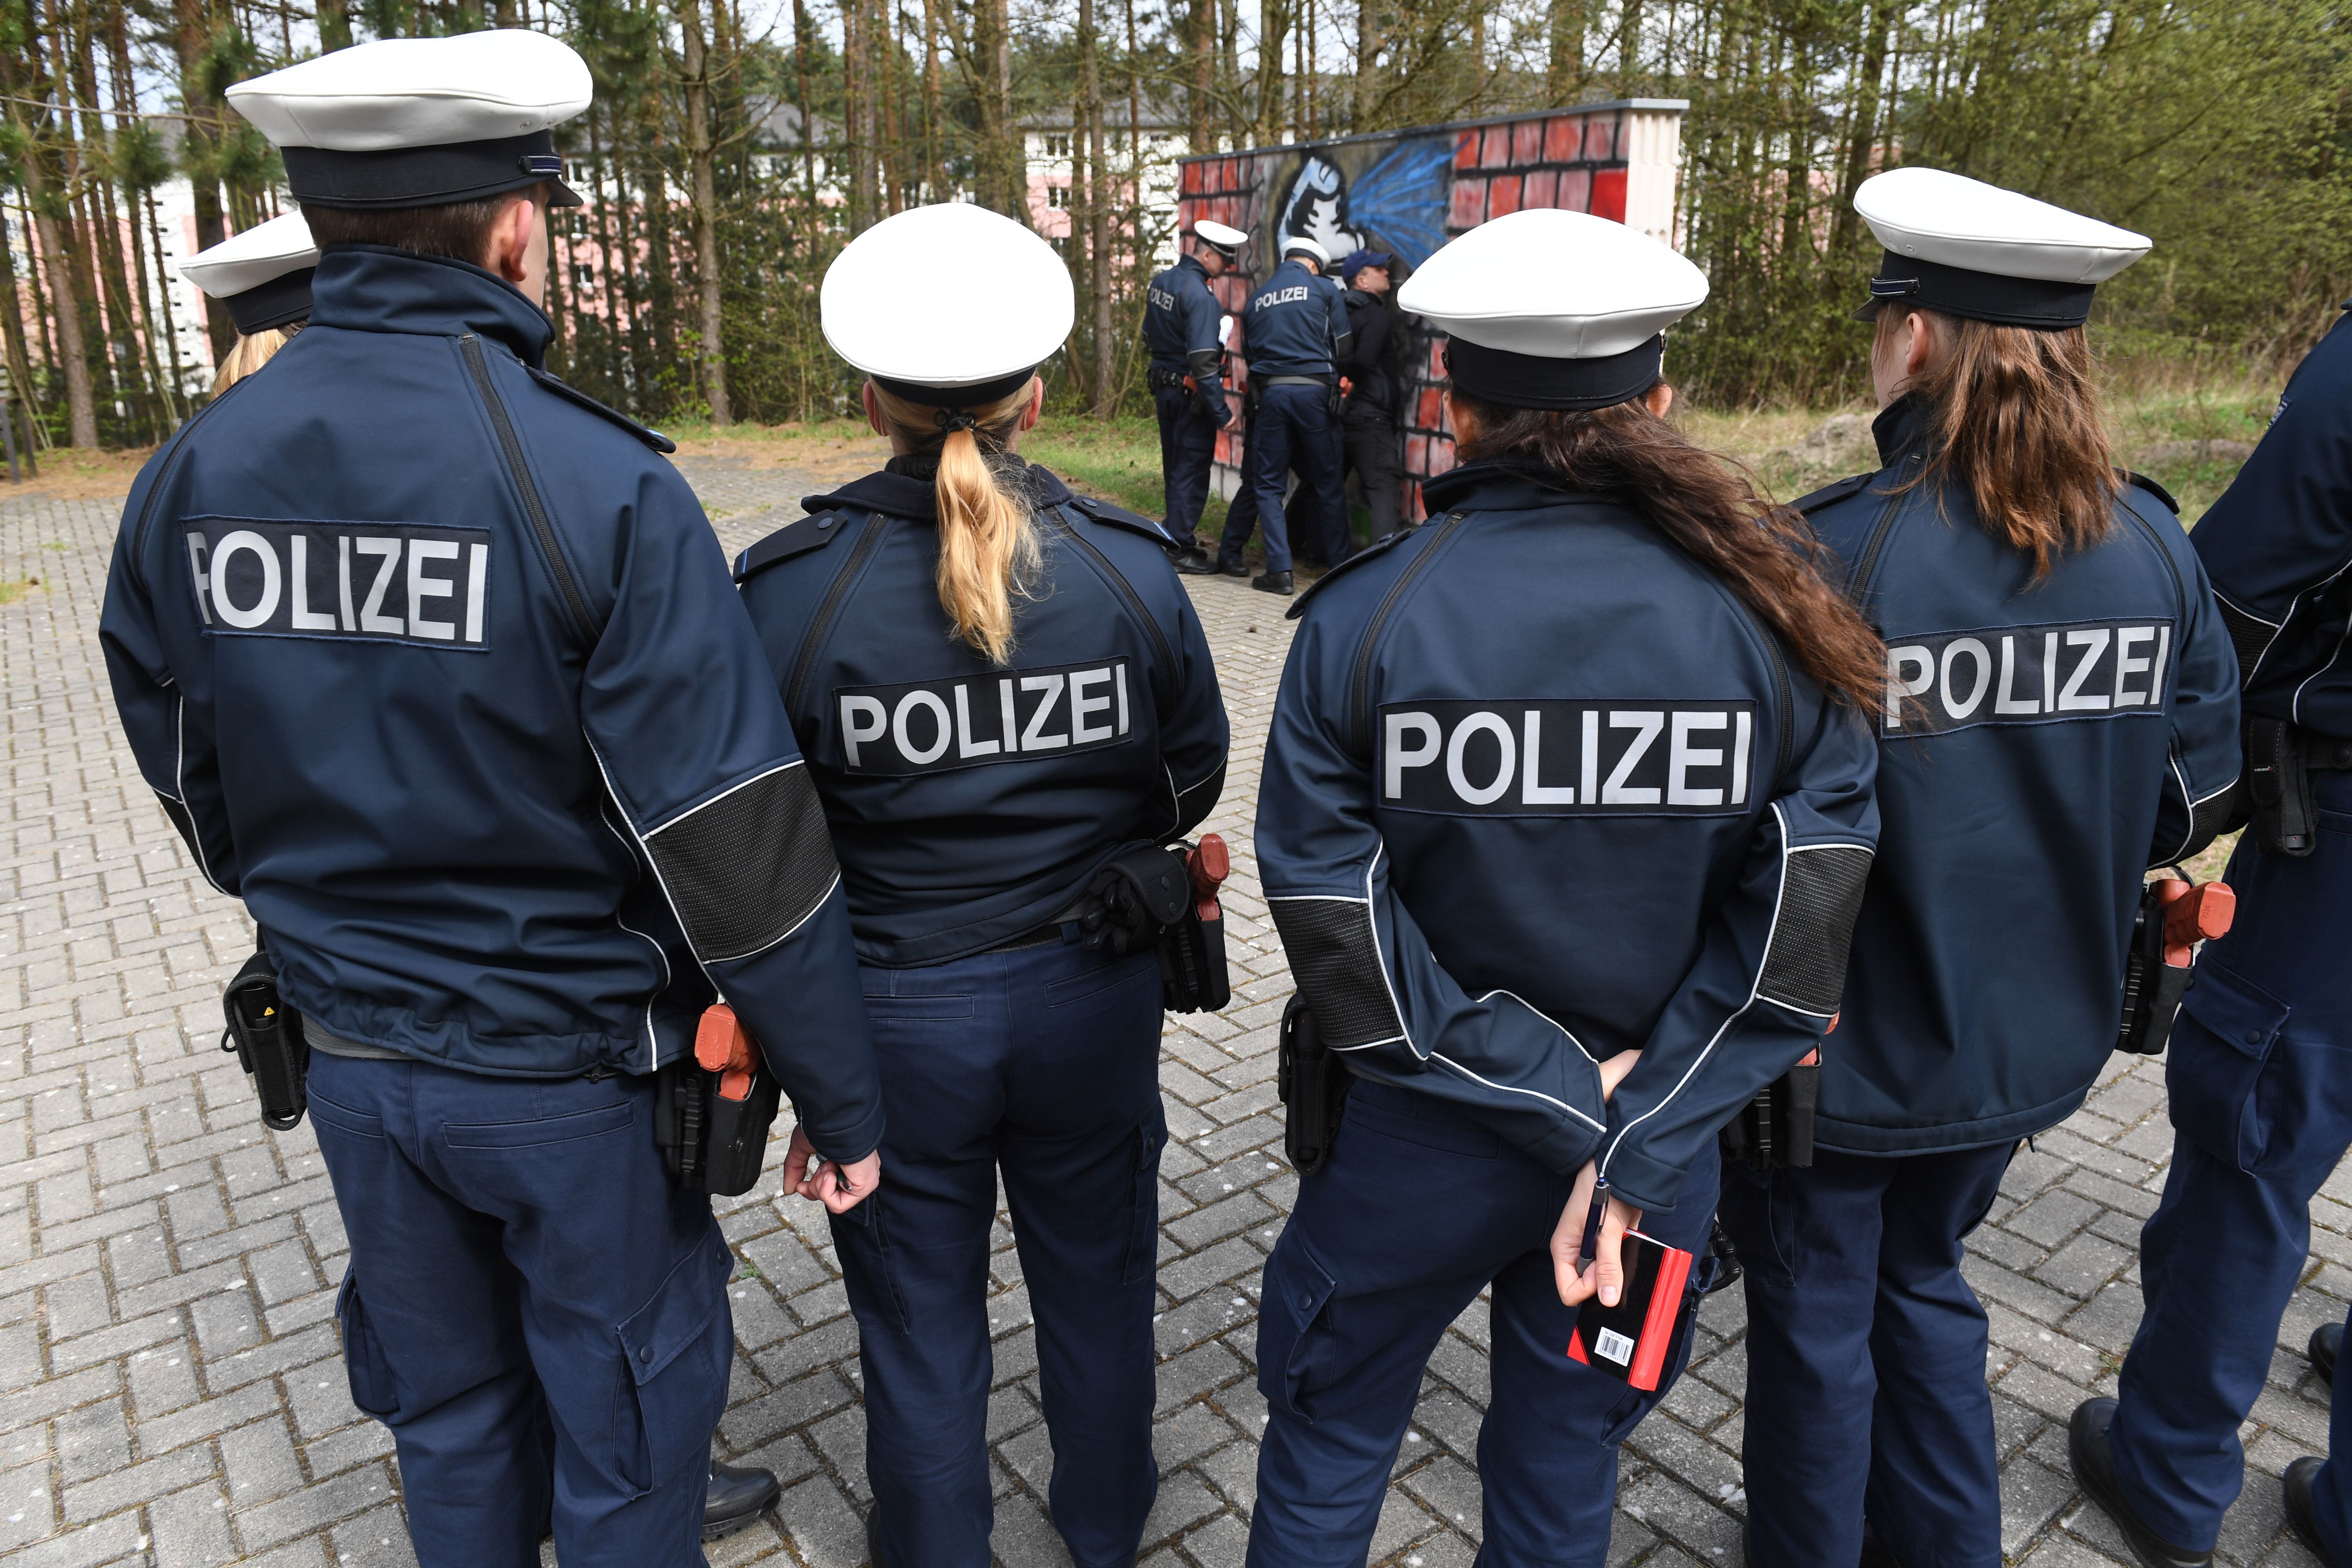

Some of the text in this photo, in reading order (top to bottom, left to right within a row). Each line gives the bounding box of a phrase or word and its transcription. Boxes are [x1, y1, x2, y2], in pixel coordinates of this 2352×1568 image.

[1255, 286, 1308, 312] POLIZEI
[186, 530, 488, 642] POLIZEI
[840, 663, 1129, 767] POLIZEI
[1886, 626, 2170, 728] POLIZEI
[1385, 710, 1751, 806] POLIZEI
